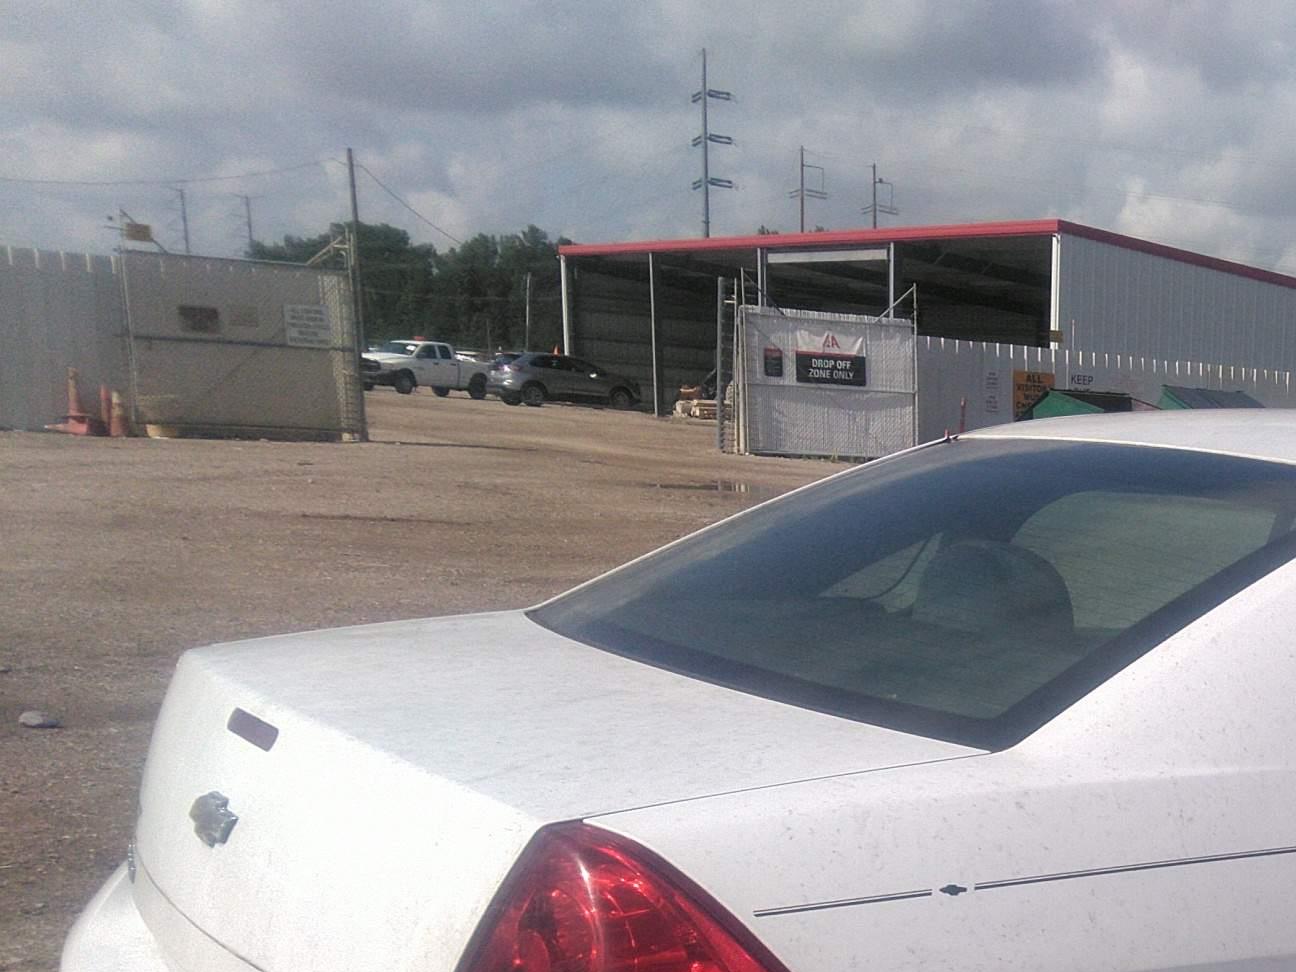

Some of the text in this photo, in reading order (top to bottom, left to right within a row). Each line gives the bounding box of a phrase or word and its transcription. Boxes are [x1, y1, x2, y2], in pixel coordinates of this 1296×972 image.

[811, 358, 852, 370] DROP OFF
[807, 368, 855, 380] ZONE ONLY
[1026, 374, 1043, 384] ALL
[1070, 374, 1094, 385] KEEP
